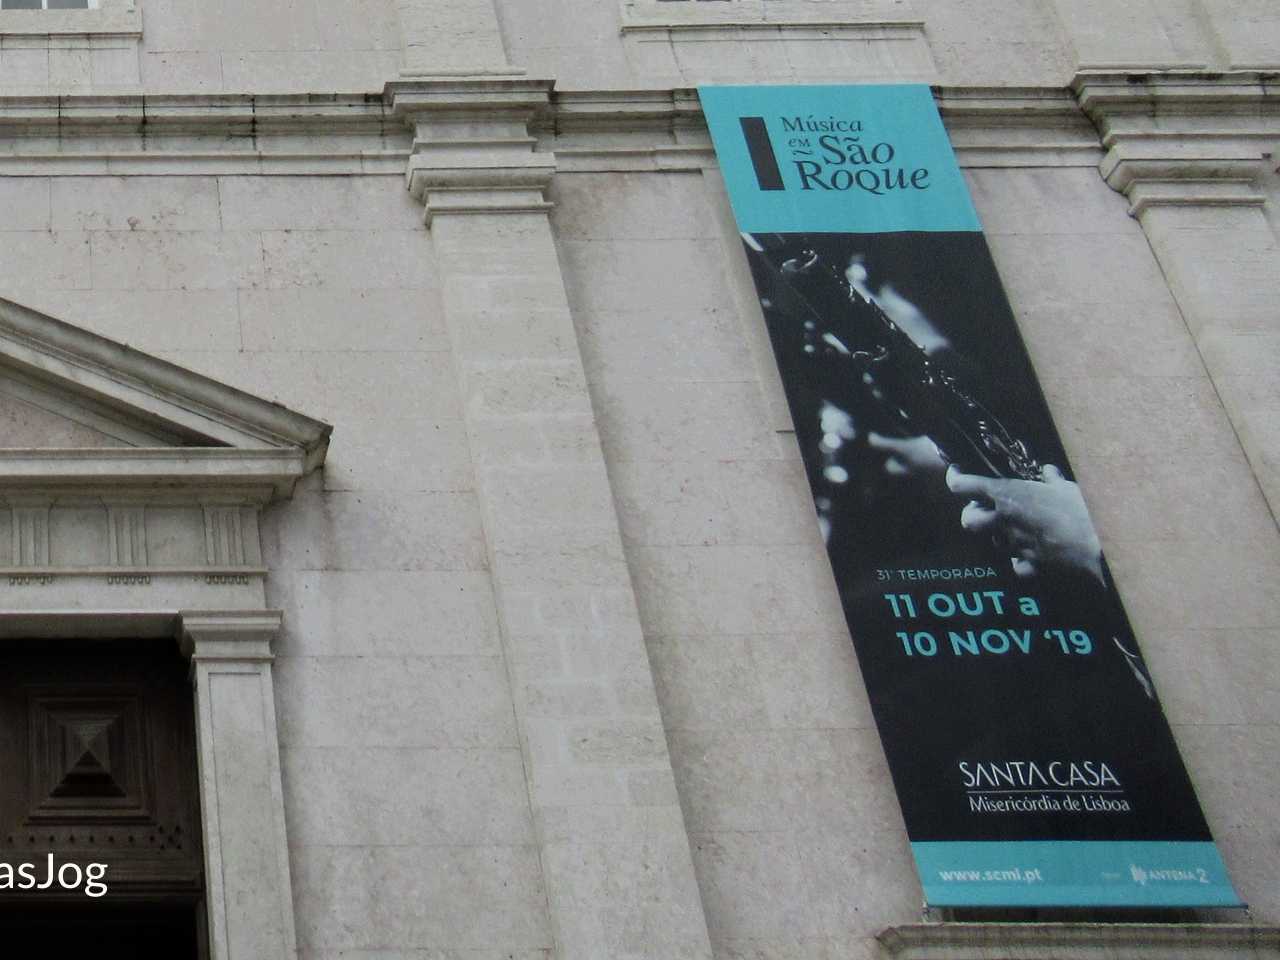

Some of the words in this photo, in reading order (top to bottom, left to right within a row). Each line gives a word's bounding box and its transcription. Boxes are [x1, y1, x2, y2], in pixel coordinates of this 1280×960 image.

[781, 114, 864, 132] Música
[819, 135, 895, 165] São
[898, 567, 997, 581] TEMPORADA
[884, 594, 917, 618] 11
[927, 591, 1005, 617] OUT
[1018, 596, 1041, 616] a
[896, 631, 938, 656] 10
[949, 629, 1031, 655] NOV
[959, 761, 1048, 787] SANTA
[1049, 761, 1120, 787] CASA
[969, 794, 1061, 813] Misericórdia
[1063, 794, 1081, 812] de
[1081, 794, 1131, 812] Lisboa
[940, 868, 1043, 884] www.scml.pt
[1149, 870, 1197, 881] ANTENA
[1196, 868, 1210, 884] 2
